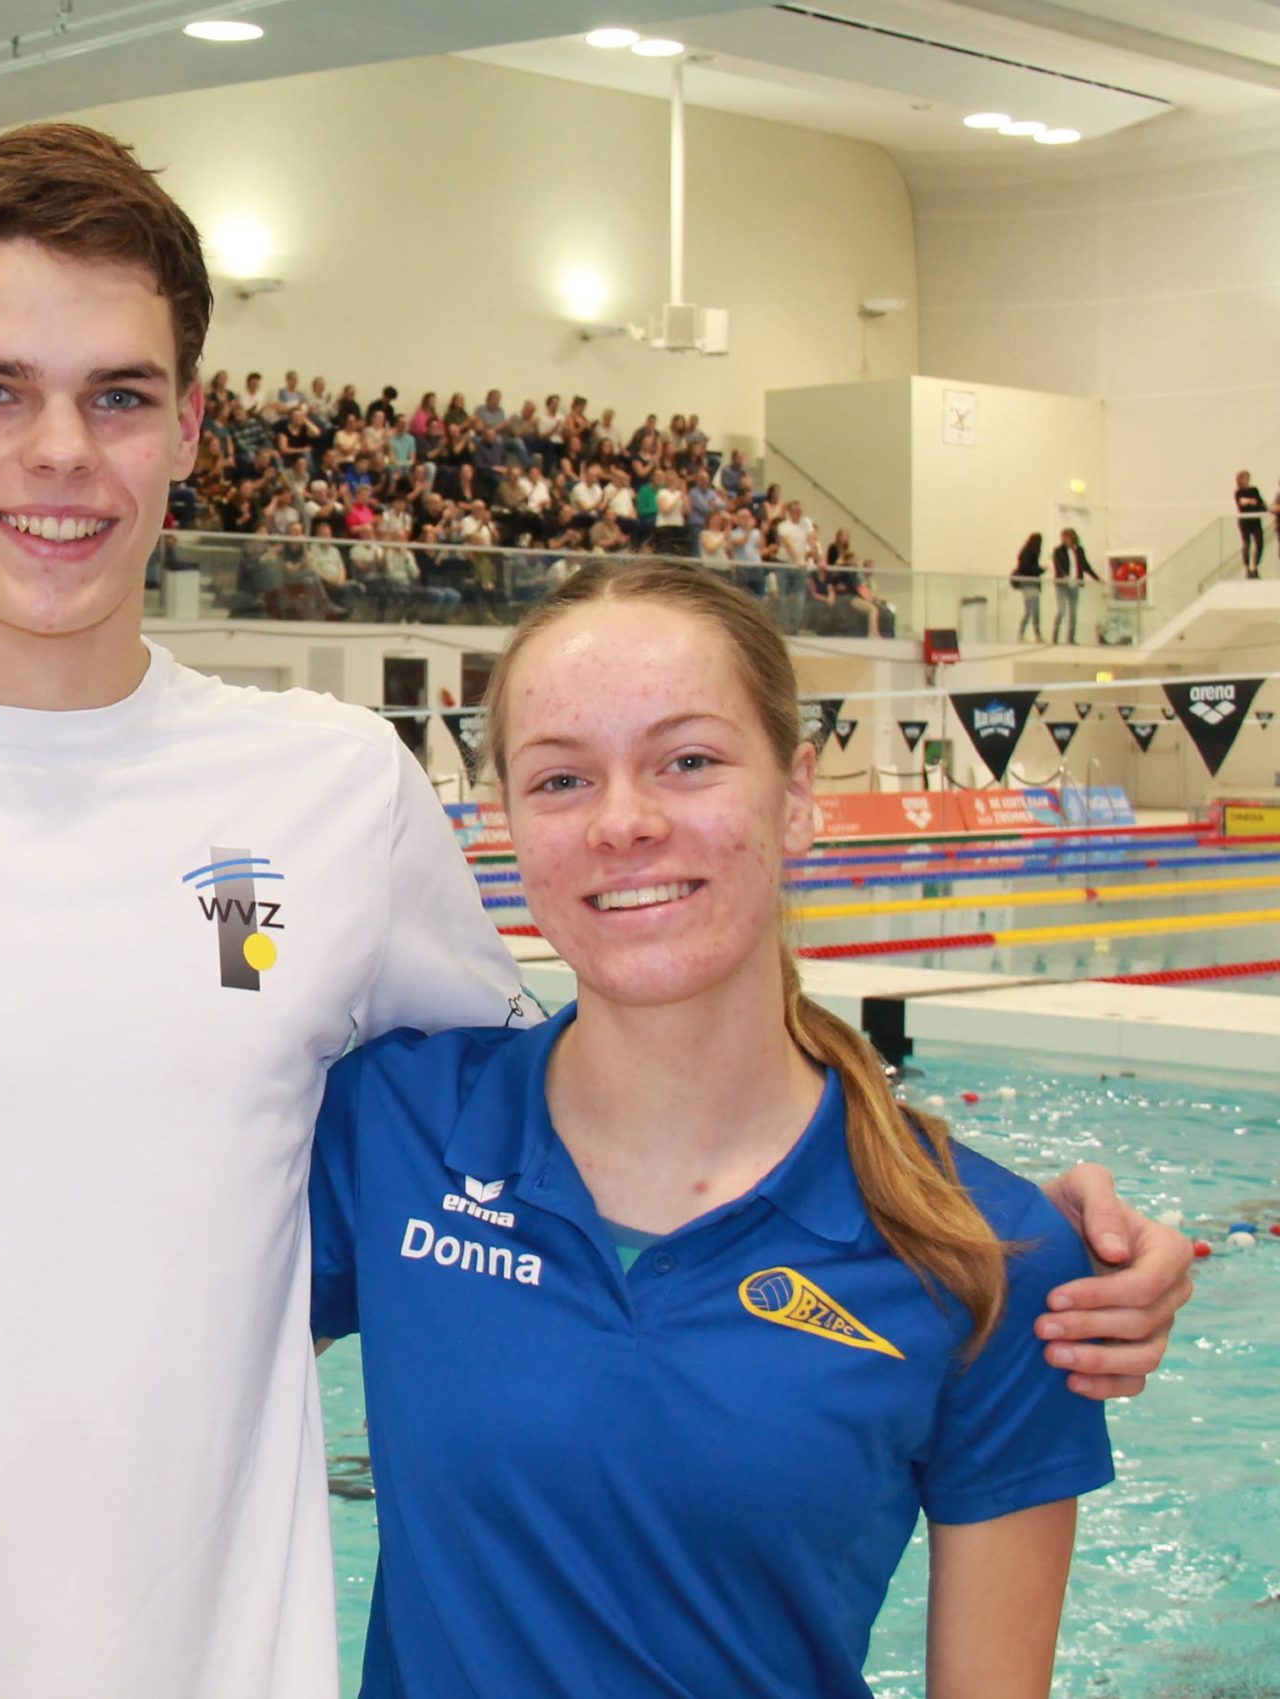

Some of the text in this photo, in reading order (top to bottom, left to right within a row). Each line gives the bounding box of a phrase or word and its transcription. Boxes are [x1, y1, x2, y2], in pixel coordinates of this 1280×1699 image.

[1190, 684, 1236, 700] arena
[198, 896, 286, 930] WVZ
[442, 1193, 516, 1229] erima
[400, 1218, 543, 1286] Donna
